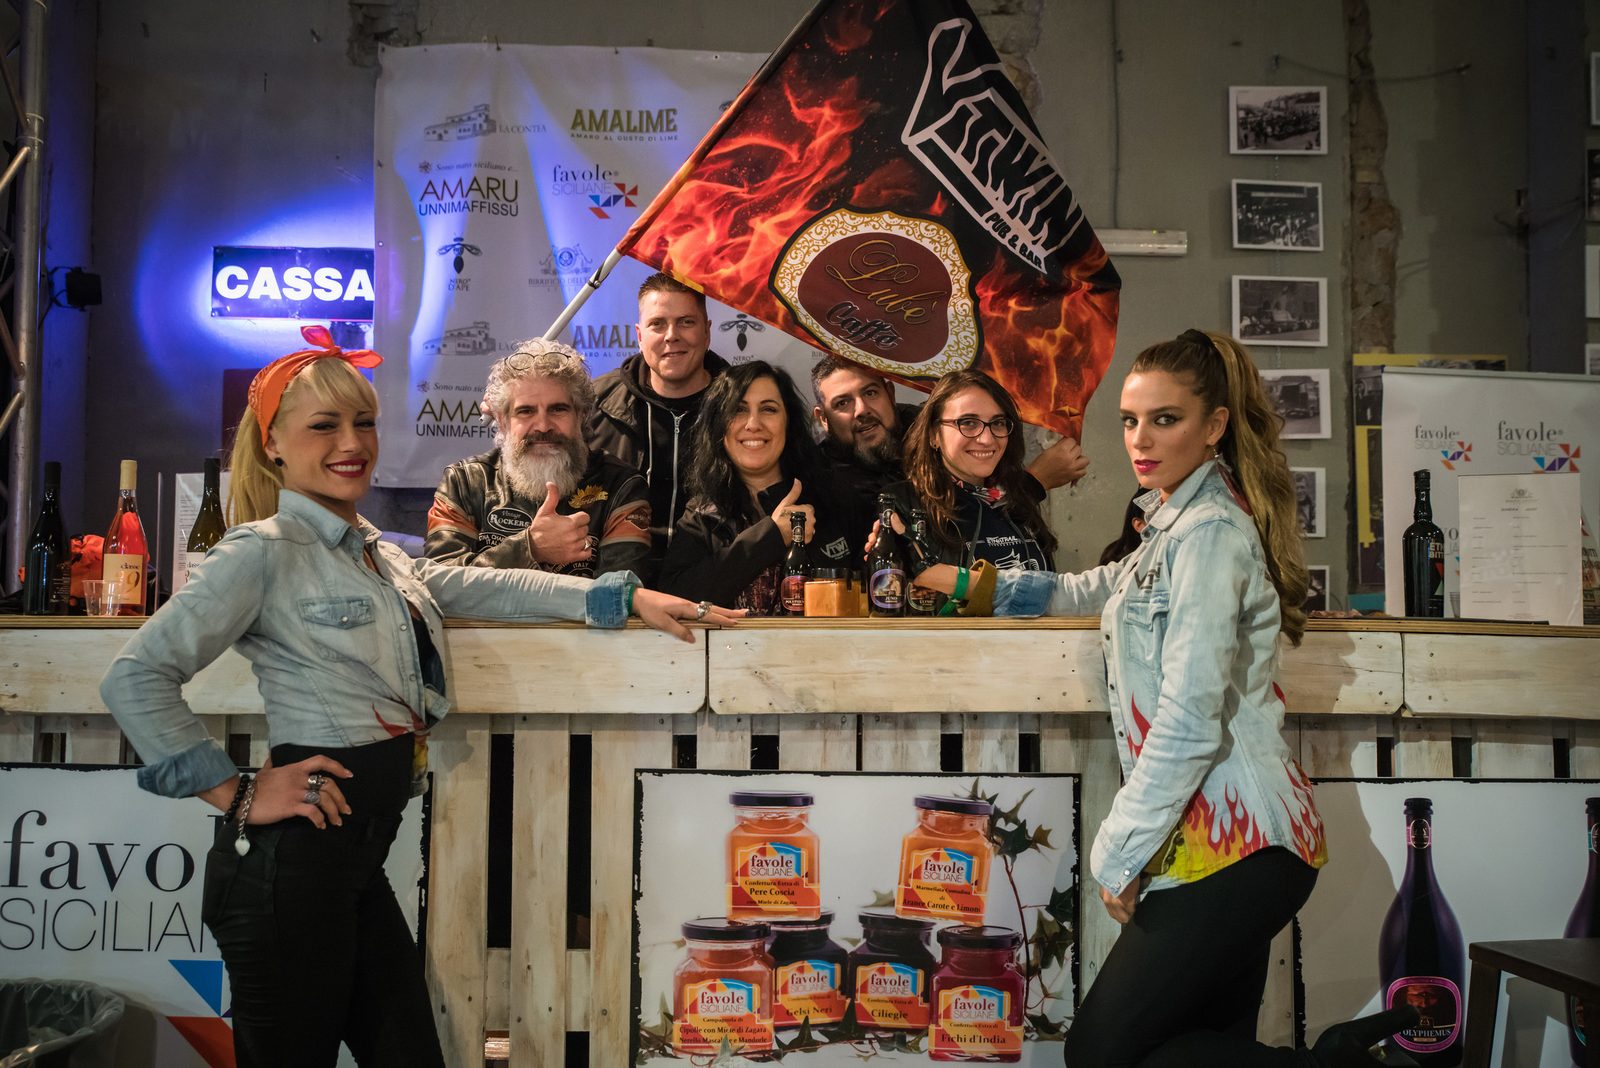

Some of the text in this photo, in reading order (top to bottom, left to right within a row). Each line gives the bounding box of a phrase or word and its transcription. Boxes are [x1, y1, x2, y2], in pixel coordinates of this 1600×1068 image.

[570, 108, 678, 133] AMALIME
[553, 163, 613, 182] favole
[419, 176, 519, 203] AMARU
[552, 182, 612, 196] SICILIANE
[418, 201, 519, 217] UNNIMAFFISSU
[984, 212, 1042, 269] PUB & BAR
[215, 265, 375, 301] CASSA
[573, 325, 641, 349] AMAL
[433, 382, 453, 391] Sono
[417, 398, 482, 423] AMA
[416, 423, 498, 439] UNNIMAFFIS
[1415, 425, 1456, 440] favole
[1497, 420, 1557, 442] favole
[1, 810, 223, 893] favo
[751, 854, 793, 867] favole
[924, 858, 964, 874] favole
[750, 867, 793, 877] SICILIANE
[923, 871, 963, 883] SICILIANE
[749, 887, 795, 896] Pere Coscia
[902, 898, 926, 907] Arance
[927, 901, 950, 909] Carote
[956, 904, 981, 913] Limoni
[0, 897, 204, 953] SICILIA
[791, 971, 828, 985] favole
[871, 973, 909, 986] favole
[701, 991, 744, 1004] favole
[954, 997, 995, 1010] favole
[700, 1004, 743, 1014] SICILIANE
[786, 1006, 832, 1016] Gelsi Neri
[871, 1008, 908, 1020] Ciliegie
[953, 1010, 994, 1019] SICILIANE
[679, 1026, 702, 1034] Cipolle
[745, 1027, 767, 1035] Zagara
[1399, 1028, 1451, 1037] OLYPHEMUS
[941, 1034, 1006, 1043] Fichi d'India
